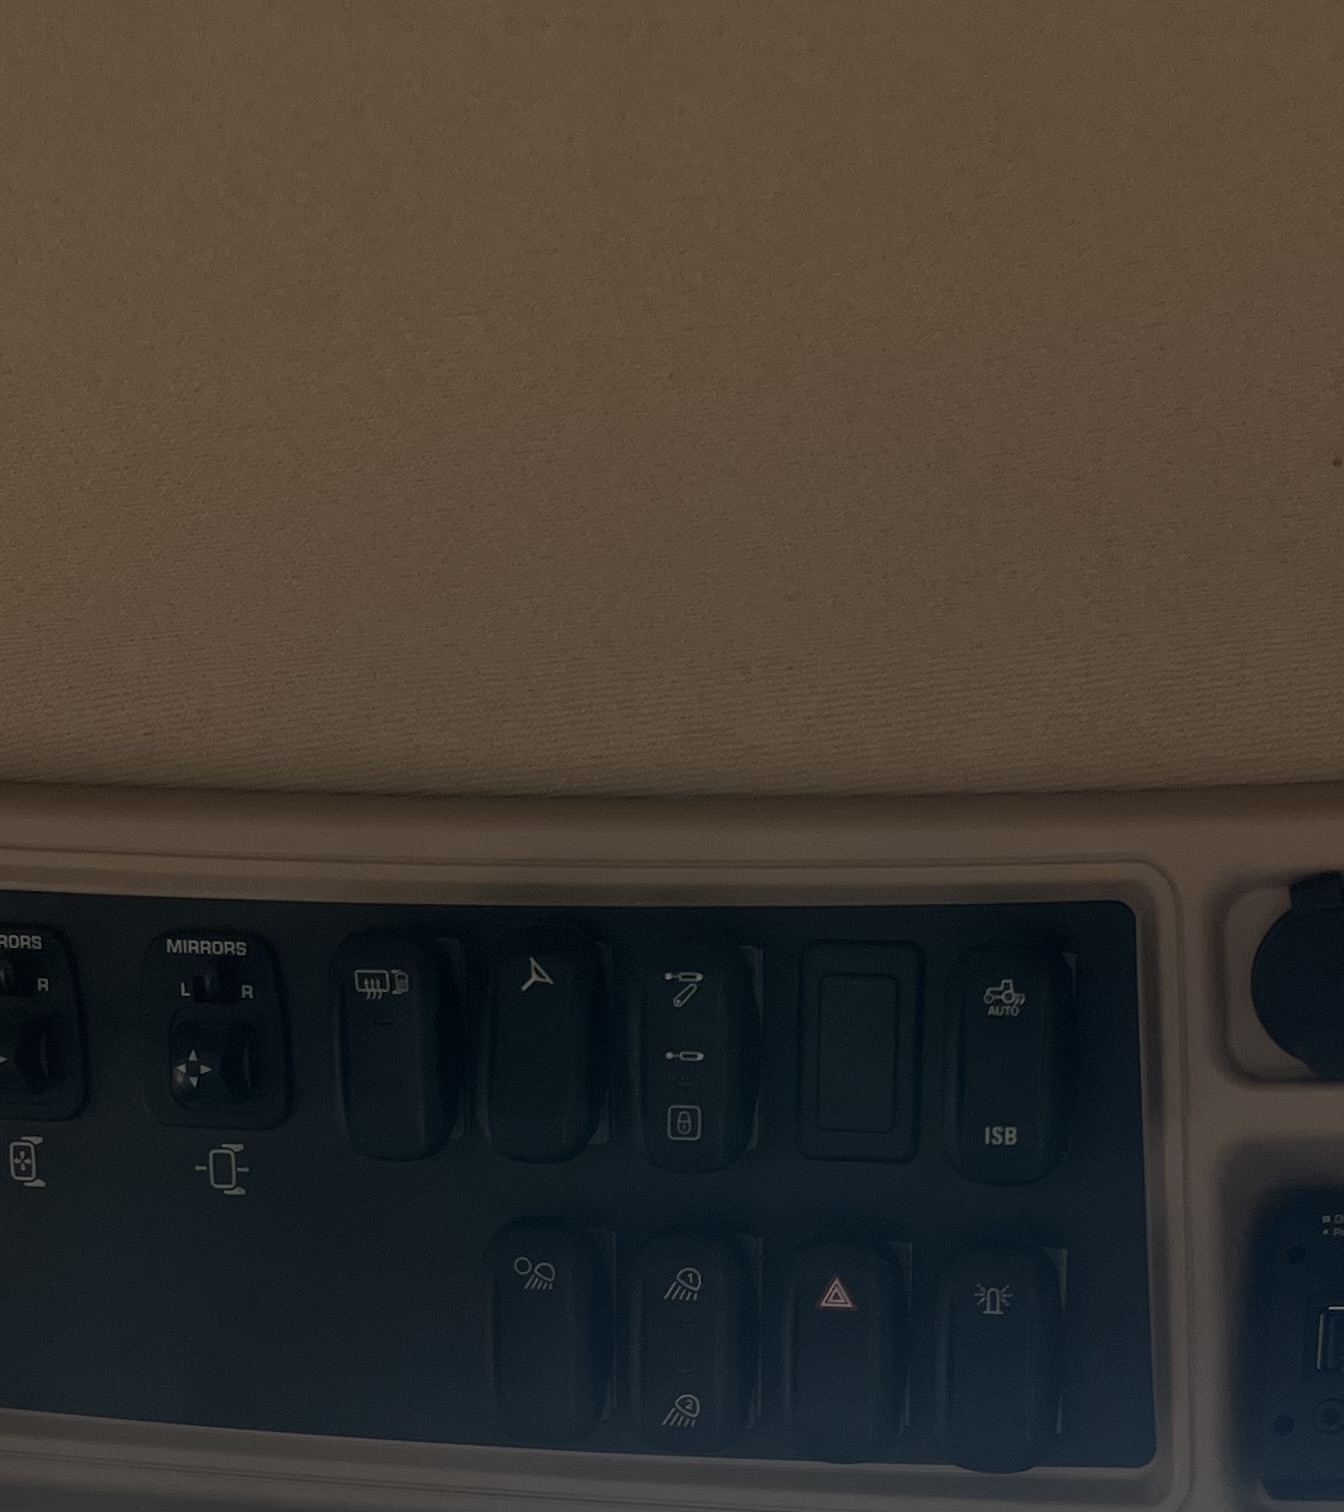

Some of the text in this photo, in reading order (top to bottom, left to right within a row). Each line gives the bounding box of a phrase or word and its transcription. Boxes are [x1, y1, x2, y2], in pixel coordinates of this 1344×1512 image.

[166, 938, 248, 956] MIRRORS
[37, 977, 50, 992] R
[179, 982, 192, 997] L
[241, 984, 254, 999] R
[987, 1005, 1020, 1017] AUTO
[984, 1125, 1018, 1146] ISB
